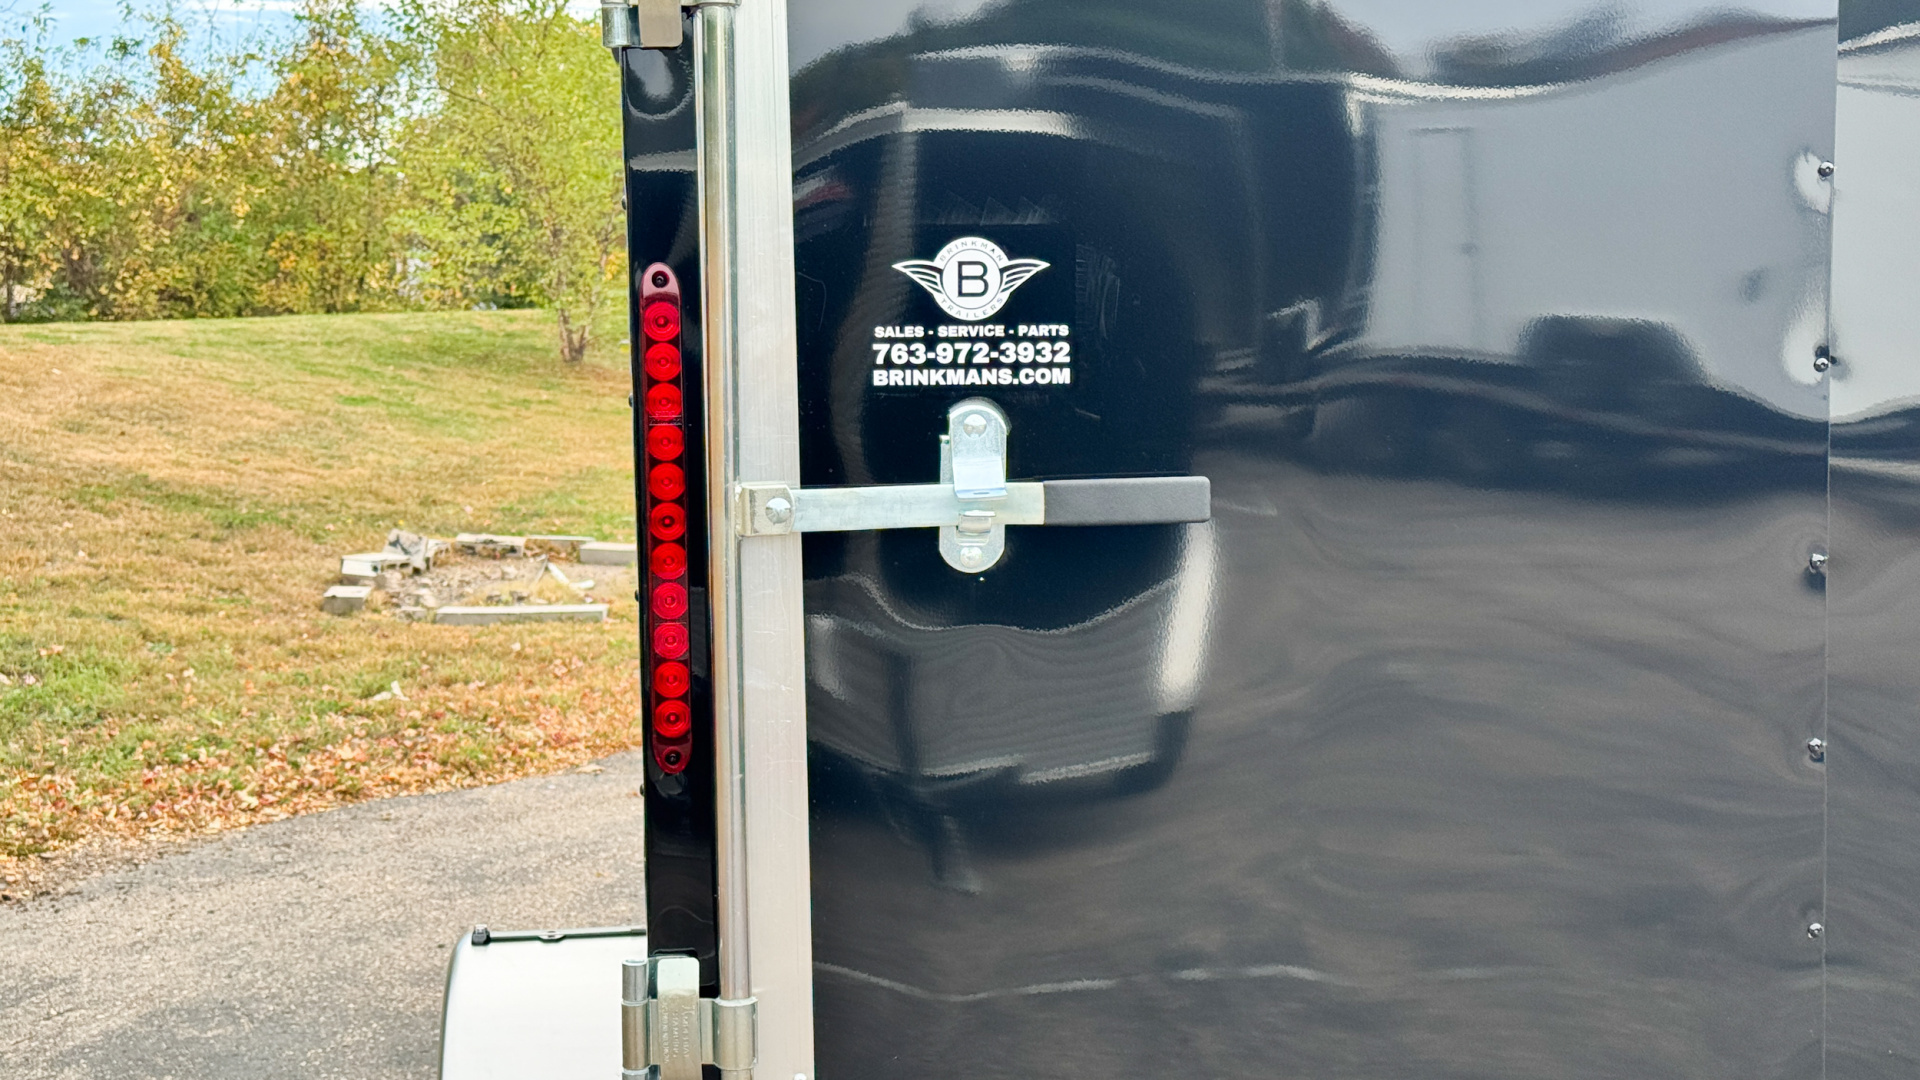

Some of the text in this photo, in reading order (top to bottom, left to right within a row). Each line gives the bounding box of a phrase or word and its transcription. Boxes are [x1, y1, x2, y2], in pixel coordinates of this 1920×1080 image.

[939, 240, 1004, 262] BRINKMAN
[957, 261, 989, 298] B
[940, 297, 1003, 319] TRAILERS
[874, 326, 924, 338] SALES
[938, 325, 1005, 337] SERVICE
[1018, 325, 1069, 337] PARTS
[872, 342, 1070, 364] 763-972-3932
[873, 368, 1070, 386] BRINKMANS.COM
